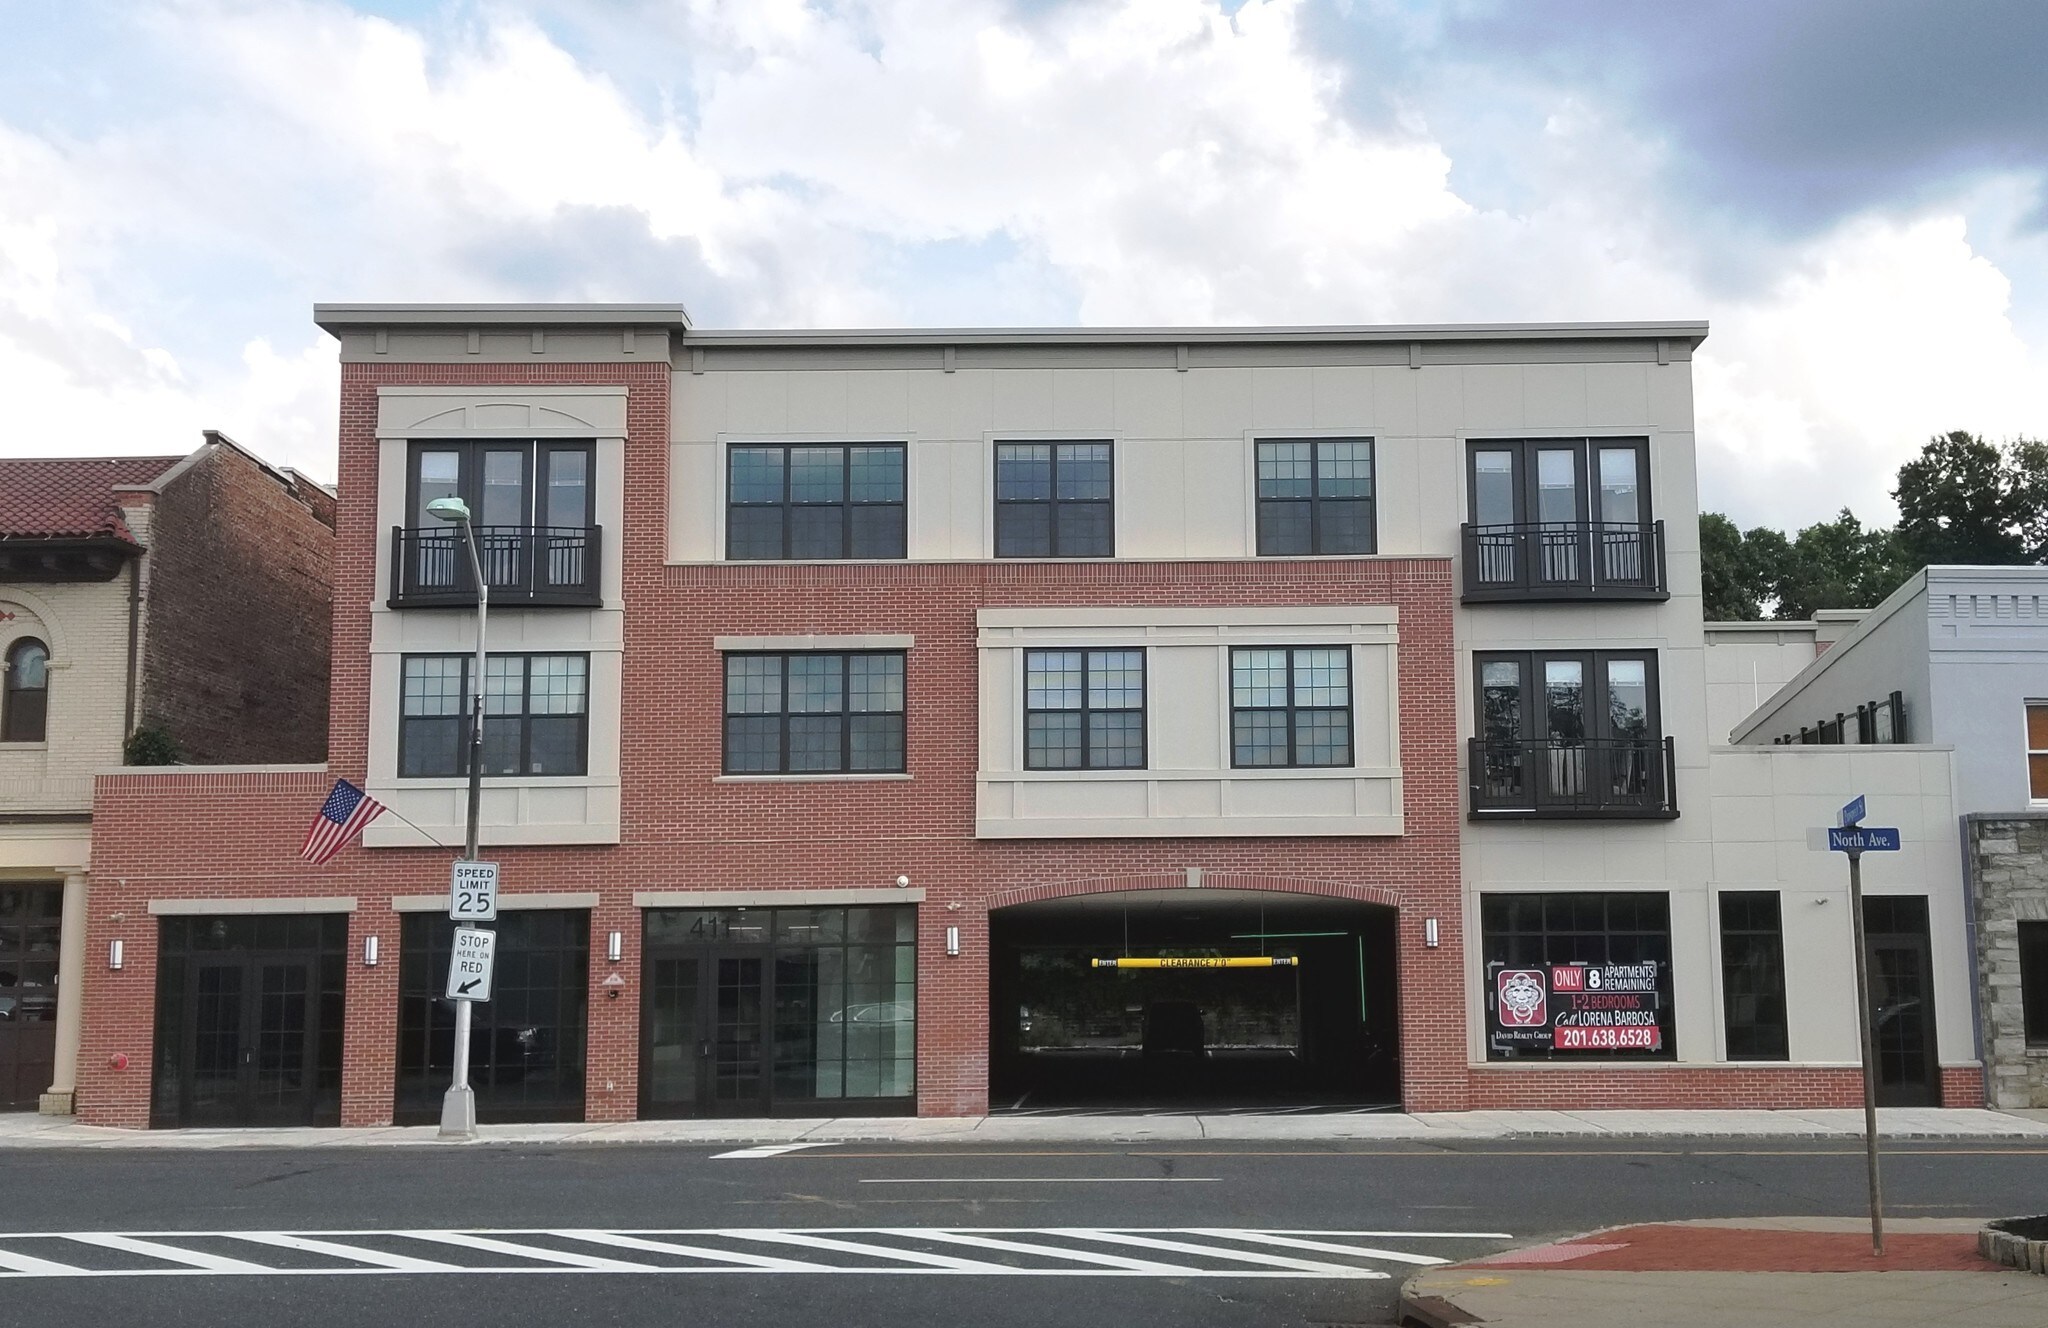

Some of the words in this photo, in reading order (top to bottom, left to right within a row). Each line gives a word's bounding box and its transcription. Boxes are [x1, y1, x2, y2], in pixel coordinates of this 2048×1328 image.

[1832, 832, 1864, 847] North
[1869, 832, 1890, 847] Ave.
[457, 868, 494, 879] SPEED
[459, 880, 490, 890] LIMIT
[458, 892, 490, 913] 25
[690, 917, 730, 938] 411
[460, 935, 489, 948] STOP
[457, 949, 476, 959] HERE
[480, 951, 489, 960] ON
[460, 961, 483, 974] RED
[1160, 958, 1211, 968] CLEARANCE
[1554, 970, 1581, 987] ONLY
[1589, 969, 1601, 988] 8
[1604, 965, 1654, 979] APARTMENTS
[1604, 978, 1655, 991] REMAINING!
[1571, 994, 1589, 1010] 1-2
[1591, 995, 1641, 1010] BEDROOMS
[1555, 1011, 1578, 1027] Call
[1578, 1010, 1613, 1027] LORENA
[1615, 1010, 1655, 1026] BARBOSA
[1564, 1029, 1651, 1046] 201.638.6528
